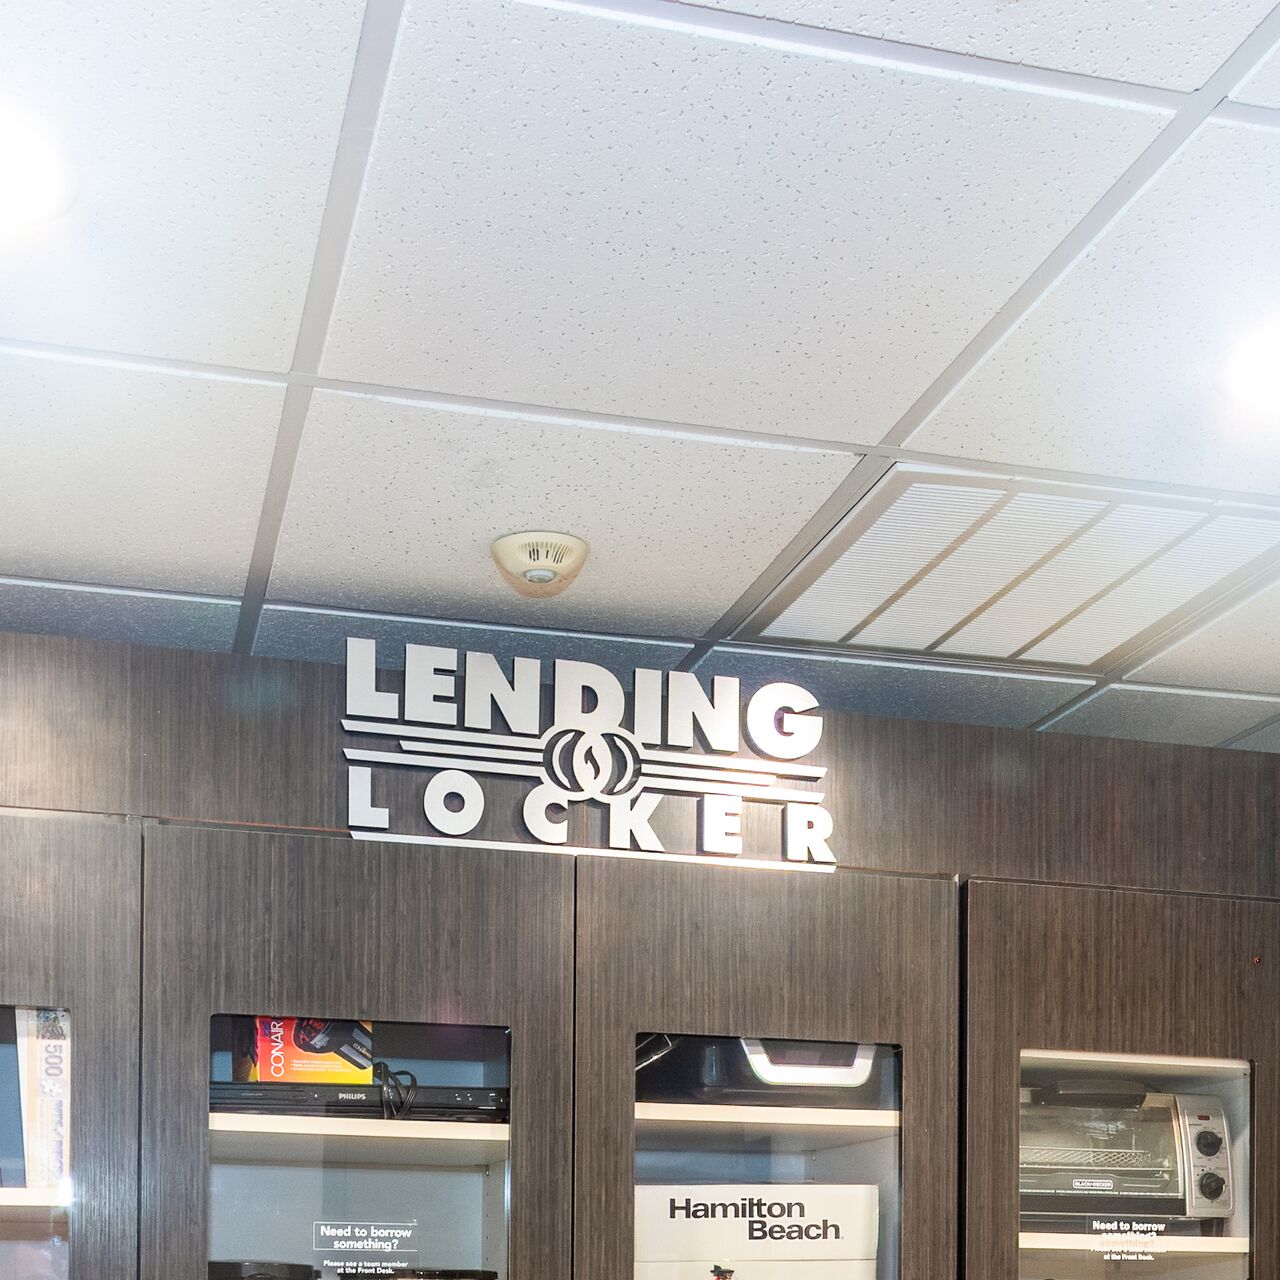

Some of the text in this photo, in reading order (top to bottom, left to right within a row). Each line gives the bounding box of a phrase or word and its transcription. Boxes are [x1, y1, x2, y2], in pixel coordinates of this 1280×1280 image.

[346, 637, 823, 760] LENDING
[348, 765, 837, 862] LOCKER
[270, 1018, 284, 1077] CONAIR
[338, 1092, 366, 1101] PHILIPS
[669, 1197, 805, 1219] Hamilton
[320, 1225, 413, 1238] Need to borrow
[748, 1219, 841, 1240] Beach
[1093, 1220, 1166, 1232] Need to borrow
[333, 1238, 399, 1252] something?
